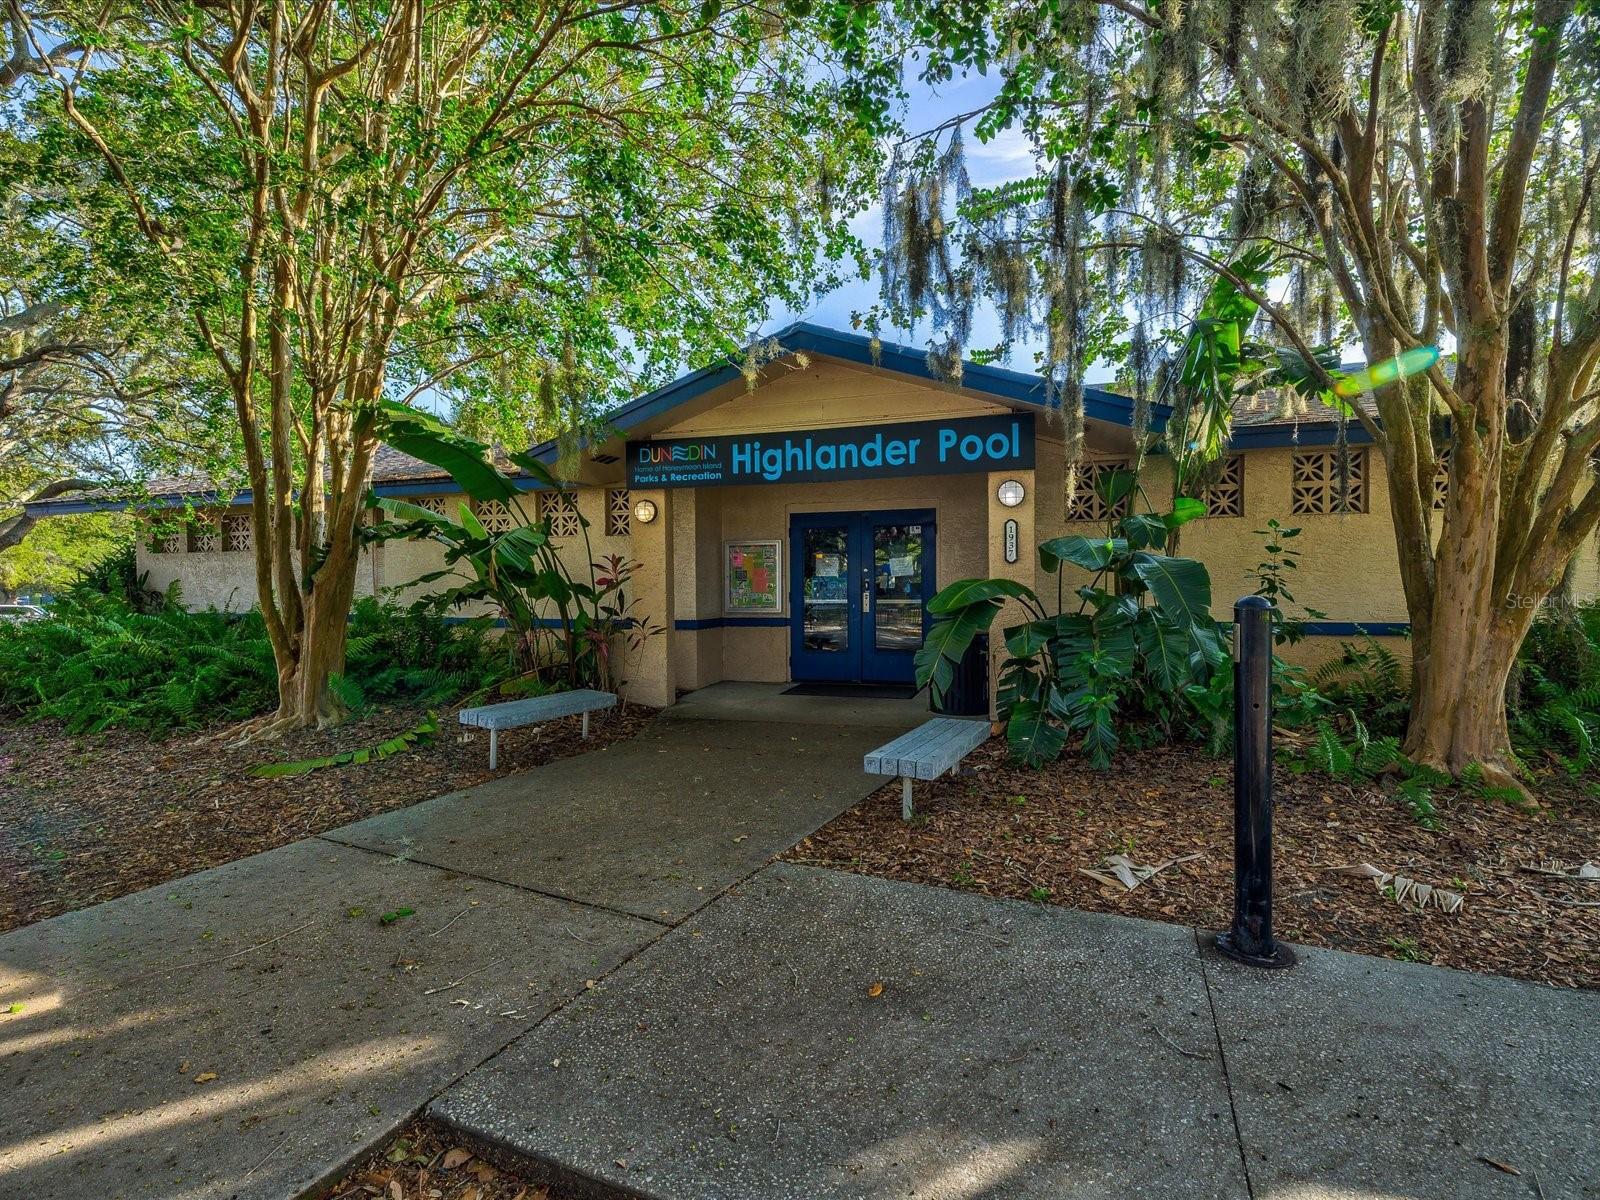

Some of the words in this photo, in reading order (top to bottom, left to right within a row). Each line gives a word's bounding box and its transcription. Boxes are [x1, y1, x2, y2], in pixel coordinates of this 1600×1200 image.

[640, 444, 716, 463] DUNEDIN
[732, 432, 920, 480] Highlander
[938, 422, 1019, 462] Pool
[662, 463, 701, 472] Honeymoon
[702, 462, 722, 470] Island
[635, 474, 659, 483] Parks
[671, 472, 722, 481] Recreation
[1007, 526, 1015, 557] 1937
